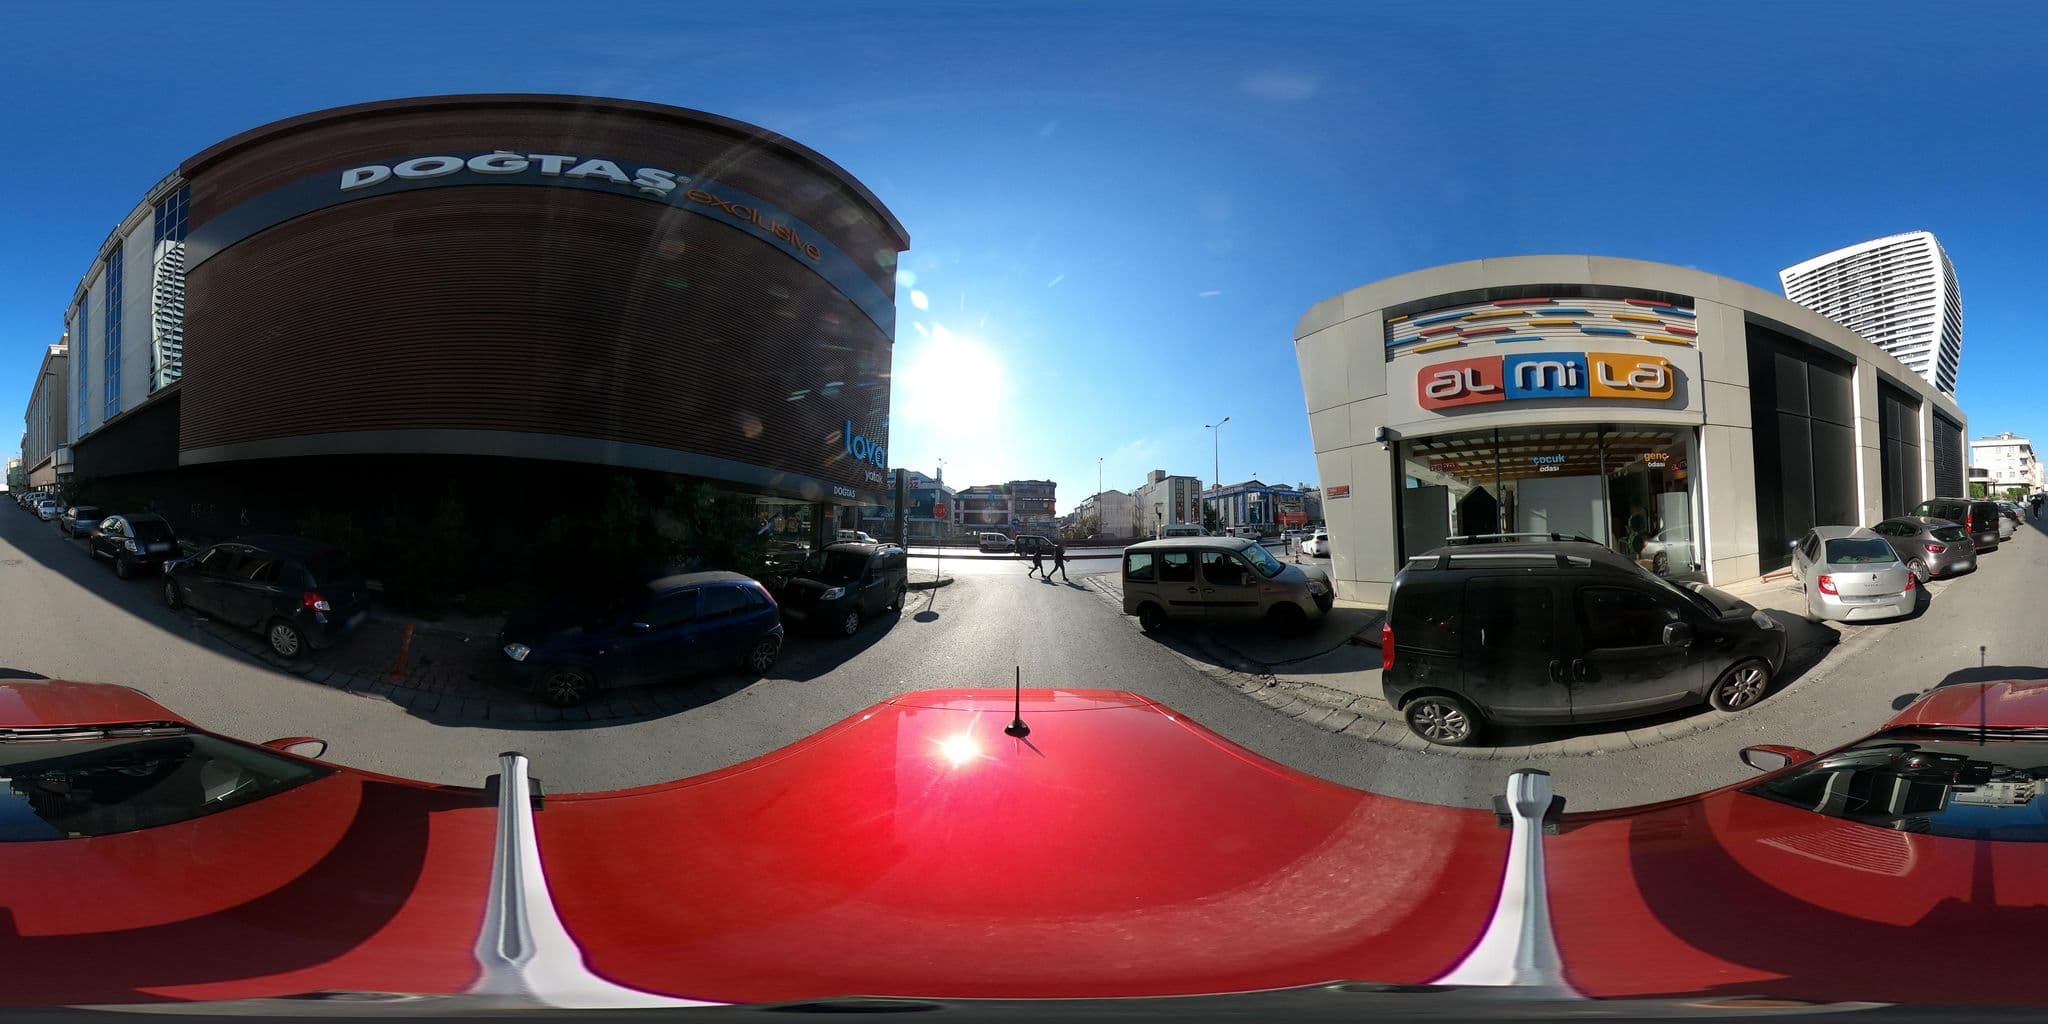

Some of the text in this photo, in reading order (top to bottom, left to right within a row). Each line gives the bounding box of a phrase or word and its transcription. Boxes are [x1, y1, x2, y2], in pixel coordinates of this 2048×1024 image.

[340, 150, 678, 197] DOĞTAŞ
[686, 187, 821, 261] exclusive
[843, 418, 885, 469] lova
